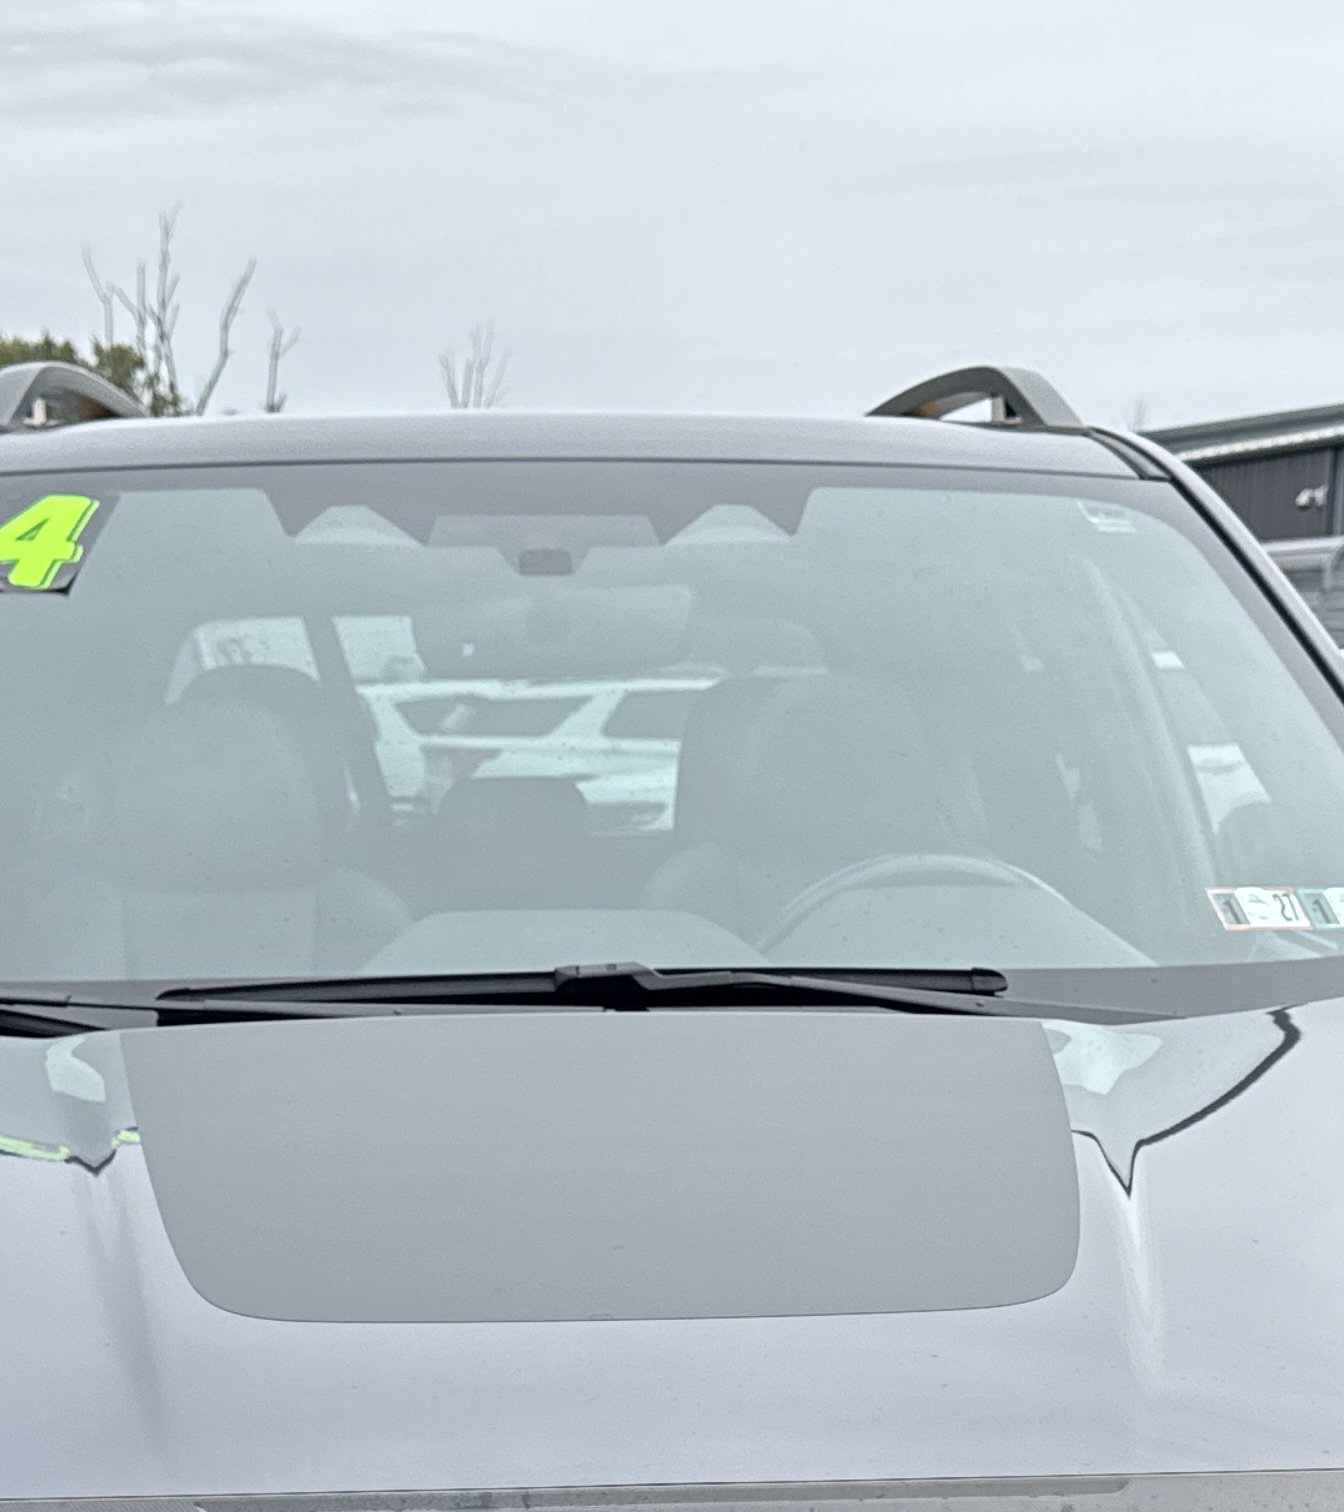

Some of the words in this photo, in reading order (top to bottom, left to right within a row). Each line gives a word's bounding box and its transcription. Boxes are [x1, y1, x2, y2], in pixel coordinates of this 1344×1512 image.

[1223, 899, 1241, 924] 1
[1272, 893, 1300, 921] 27
[1312, 899, 1332, 924] 1
